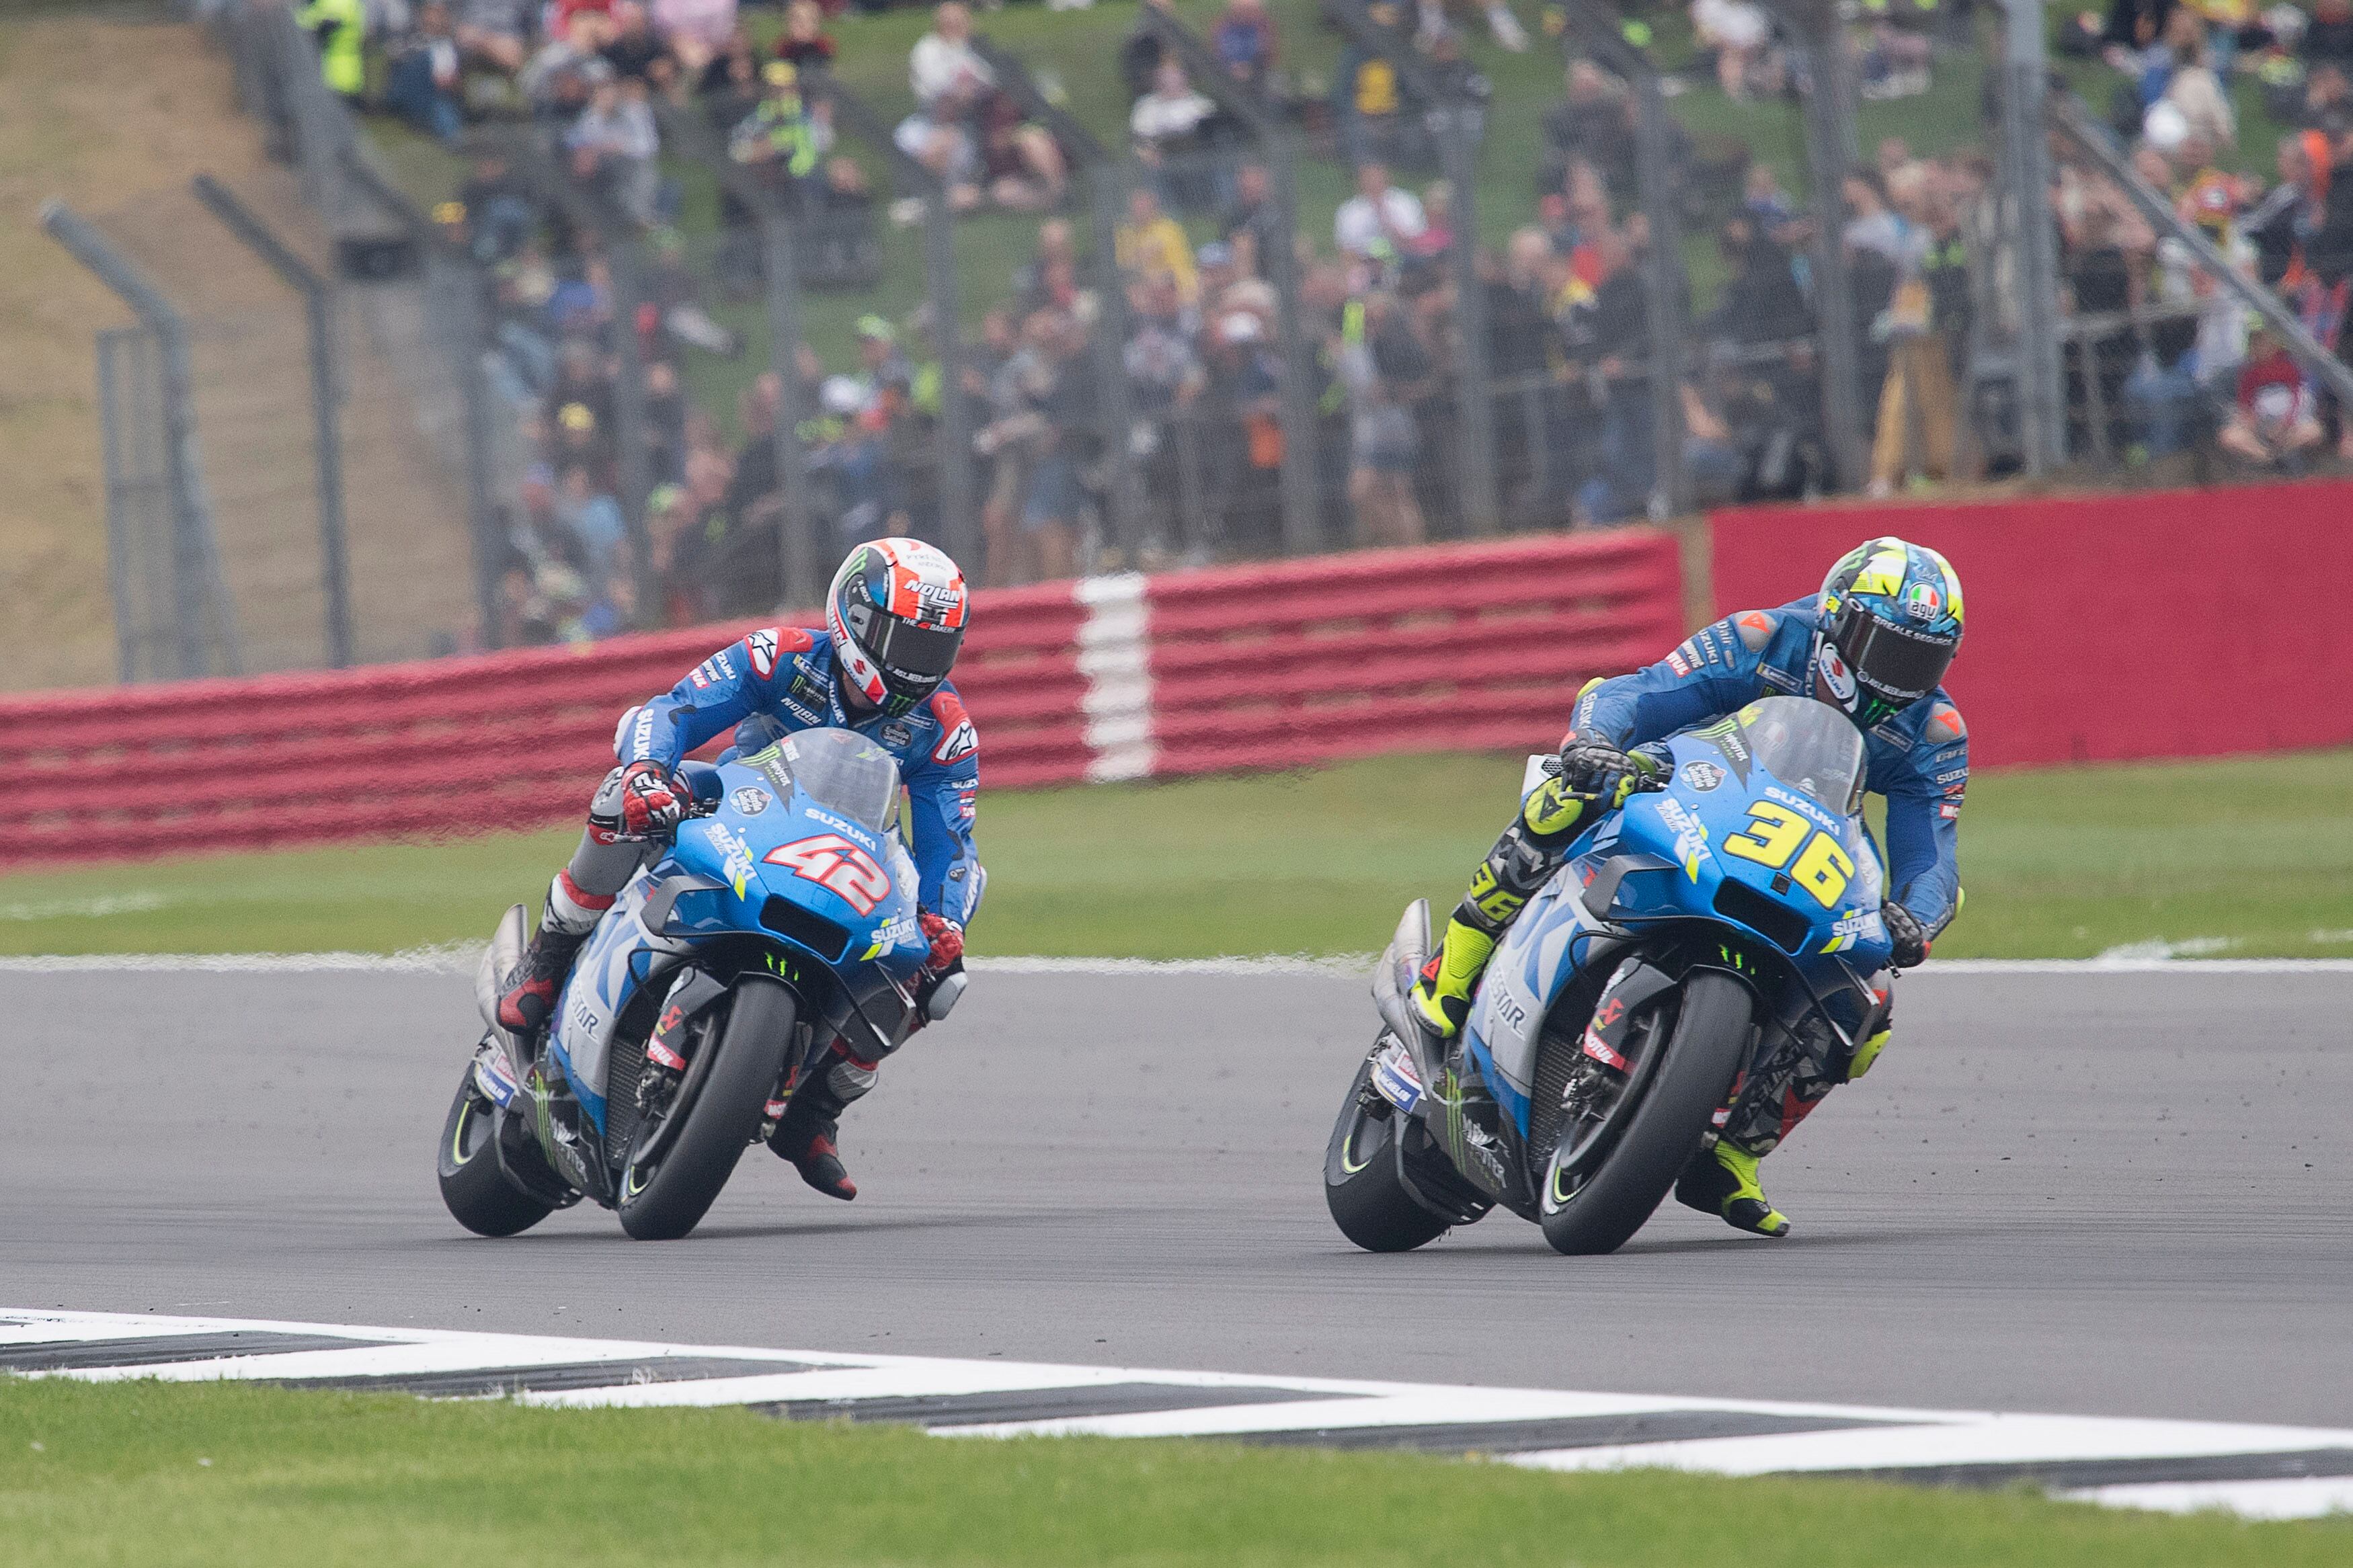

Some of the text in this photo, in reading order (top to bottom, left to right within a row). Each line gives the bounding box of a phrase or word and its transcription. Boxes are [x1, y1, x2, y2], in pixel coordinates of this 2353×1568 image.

[904, 579, 960, 608] NOLAN
[781, 697, 822, 726] NOLAN
[828, 681, 846, 724] SUZUKI
[805, 808, 876, 851] SUZUKI
[1661, 798, 1712, 861] SUZUKI
[1764, 786, 1841, 836] SUZUKI
[711, 823, 758, 880] SUZUKI
[760, 833, 891, 917] 42
[1722, 800, 1856, 911] 36
[1469, 861, 1525, 922] 36
[871, 919, 916, 944] SUZUKI
